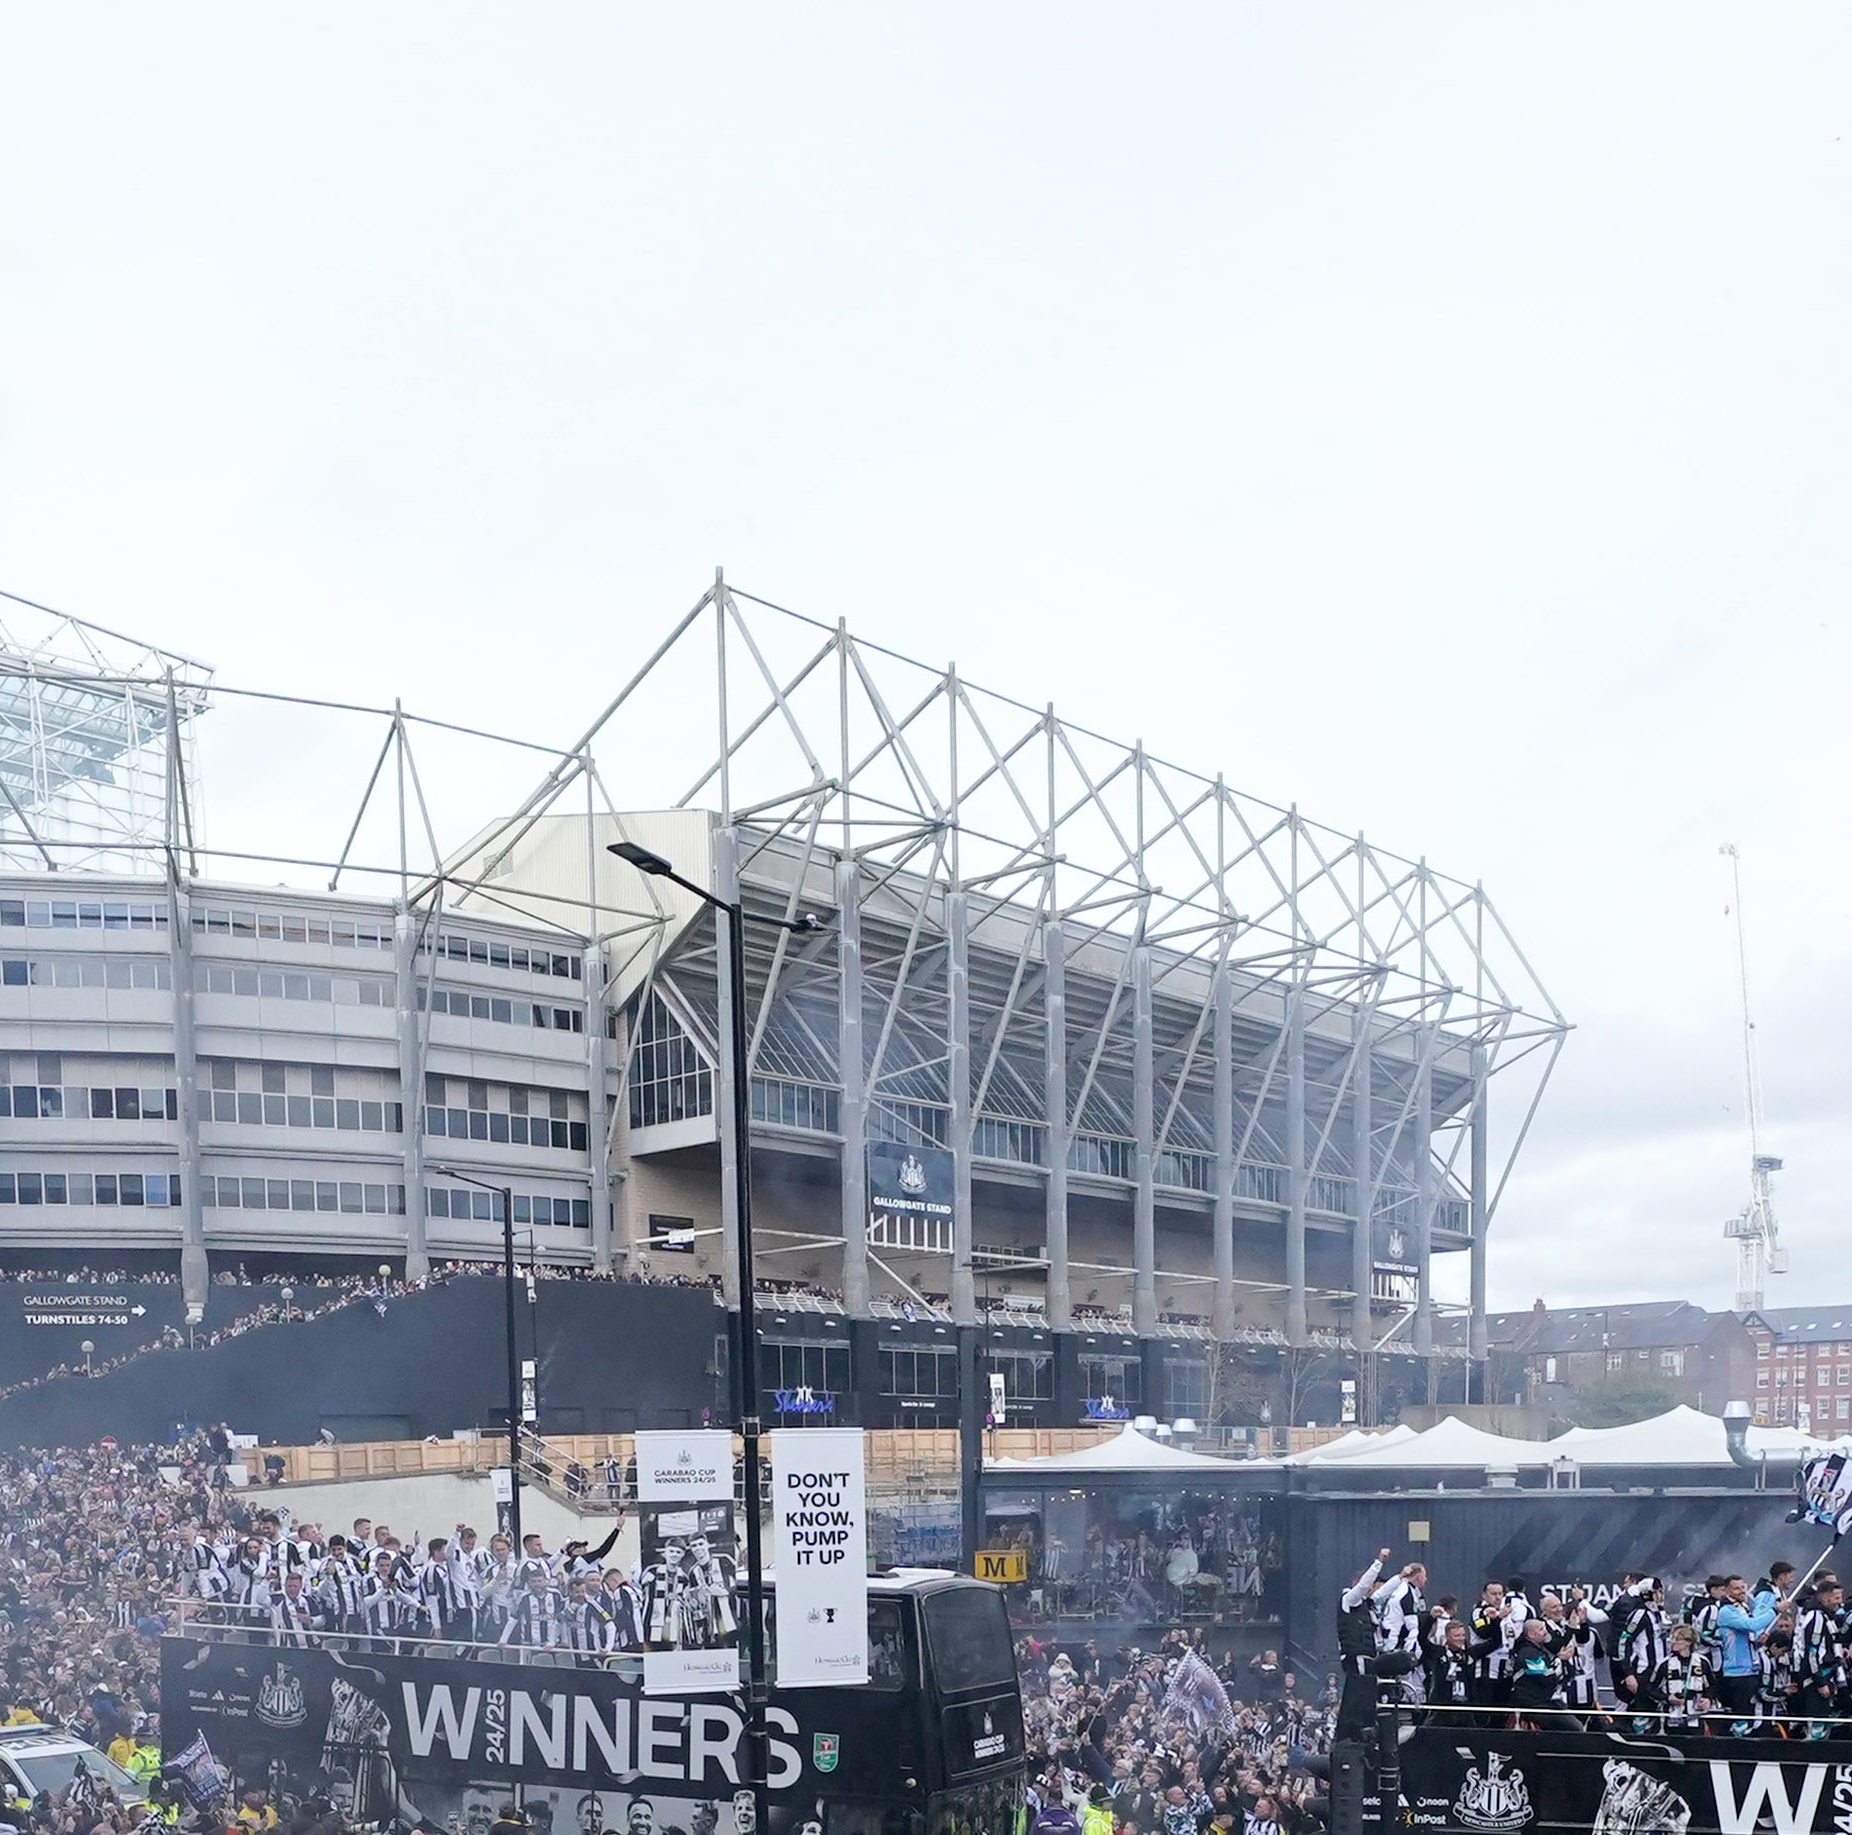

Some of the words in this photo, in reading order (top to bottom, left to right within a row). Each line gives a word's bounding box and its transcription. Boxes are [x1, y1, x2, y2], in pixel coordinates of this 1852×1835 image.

[873, 1196, 925, 1211] GALLOWGATE
[926, 1203, 952, 1214] STAND
[23, 1296, 92, 1306] GALLOWGATE
[92, 1296, 128, 1306] STAND
[25, 1314, 96, 1325] TURNSTILES
[654, 1469, 696, 1477] CARABAO
[698, 1469, 717, 1477] CUP
[787, 1473, 851, 1490] DON'T
[798, 1492, 841, 1508] YOU
[786, 1511, 855, 1529] KNOW,
[792, 1530, 850, 1547] PUMP
[797, 1550, 816, 1566] IT
[819, 1549, 846, 1565] UP
[1015, 1555, 1024, 1577] M
[983, 1556, 1007, 1578] M
[1427, 1798, 1449, 1807] noon
[1413, 1813, 1447, 1825] InPost
